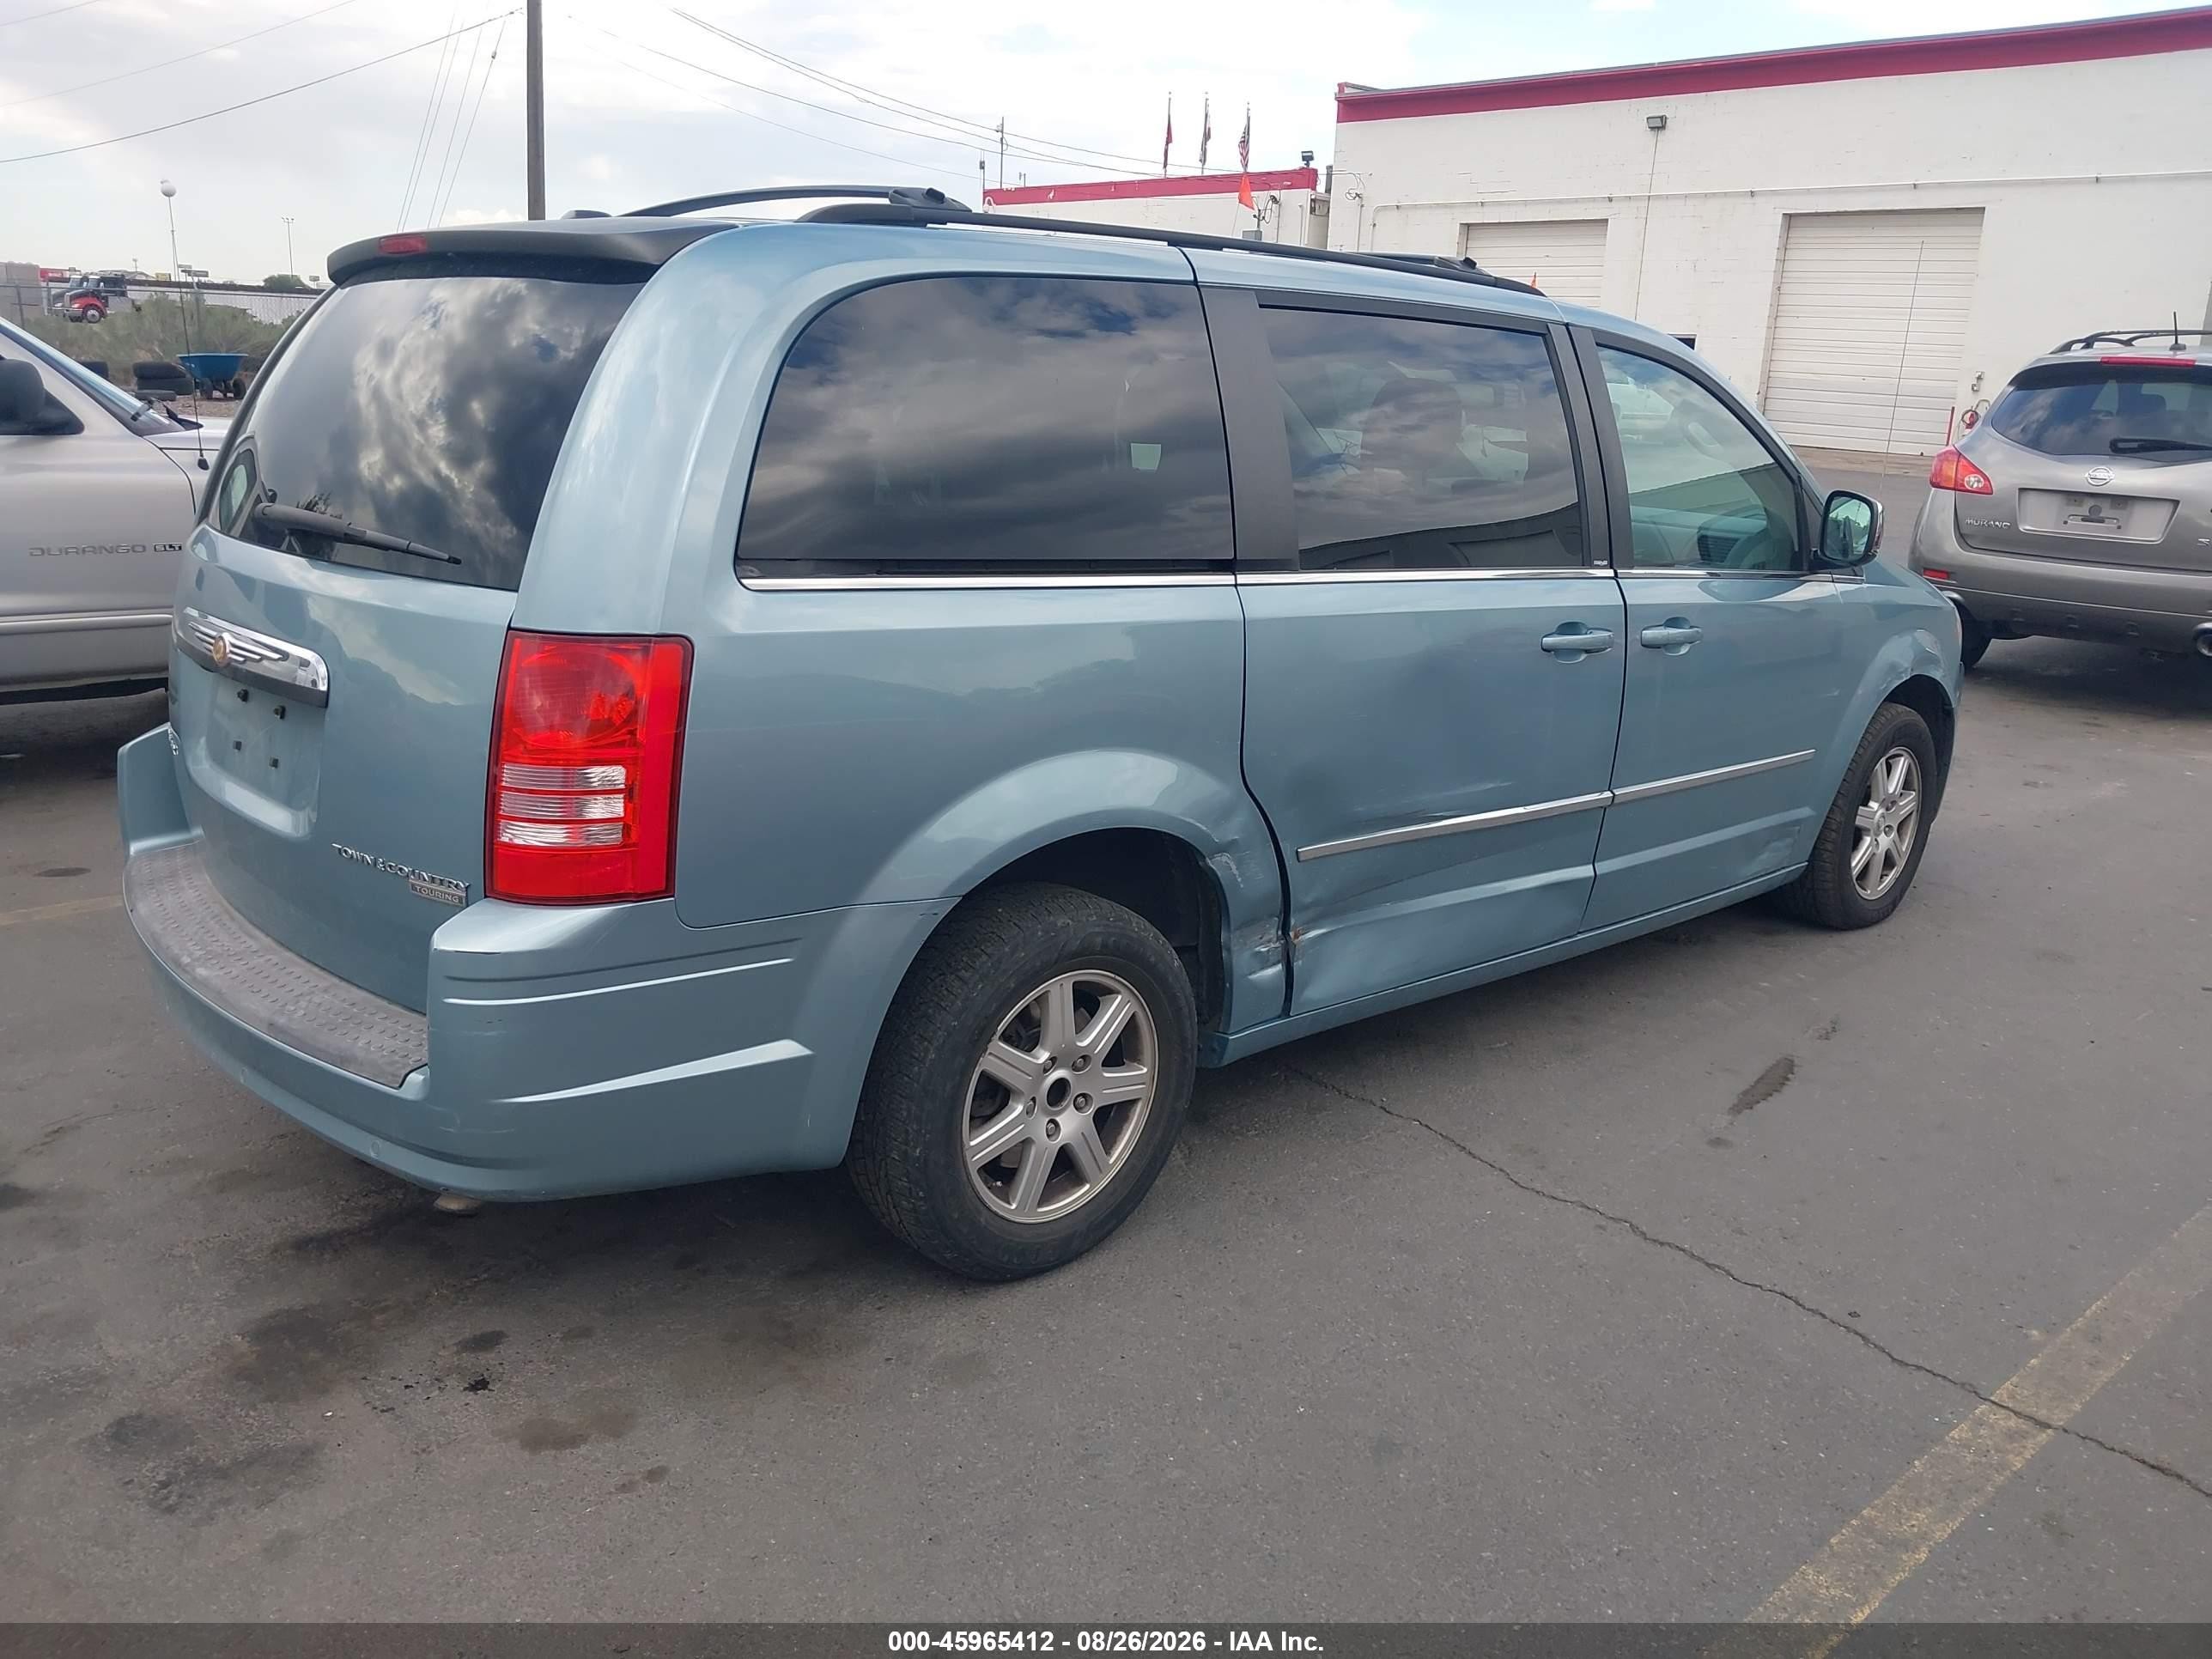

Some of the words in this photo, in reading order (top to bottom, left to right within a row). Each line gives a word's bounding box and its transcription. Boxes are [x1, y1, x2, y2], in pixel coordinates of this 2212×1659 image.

[28, 544, 147, 557] DURANGO
[154, 543, 183, 552] SLT
[415, 885, 459, 903] TOURING
